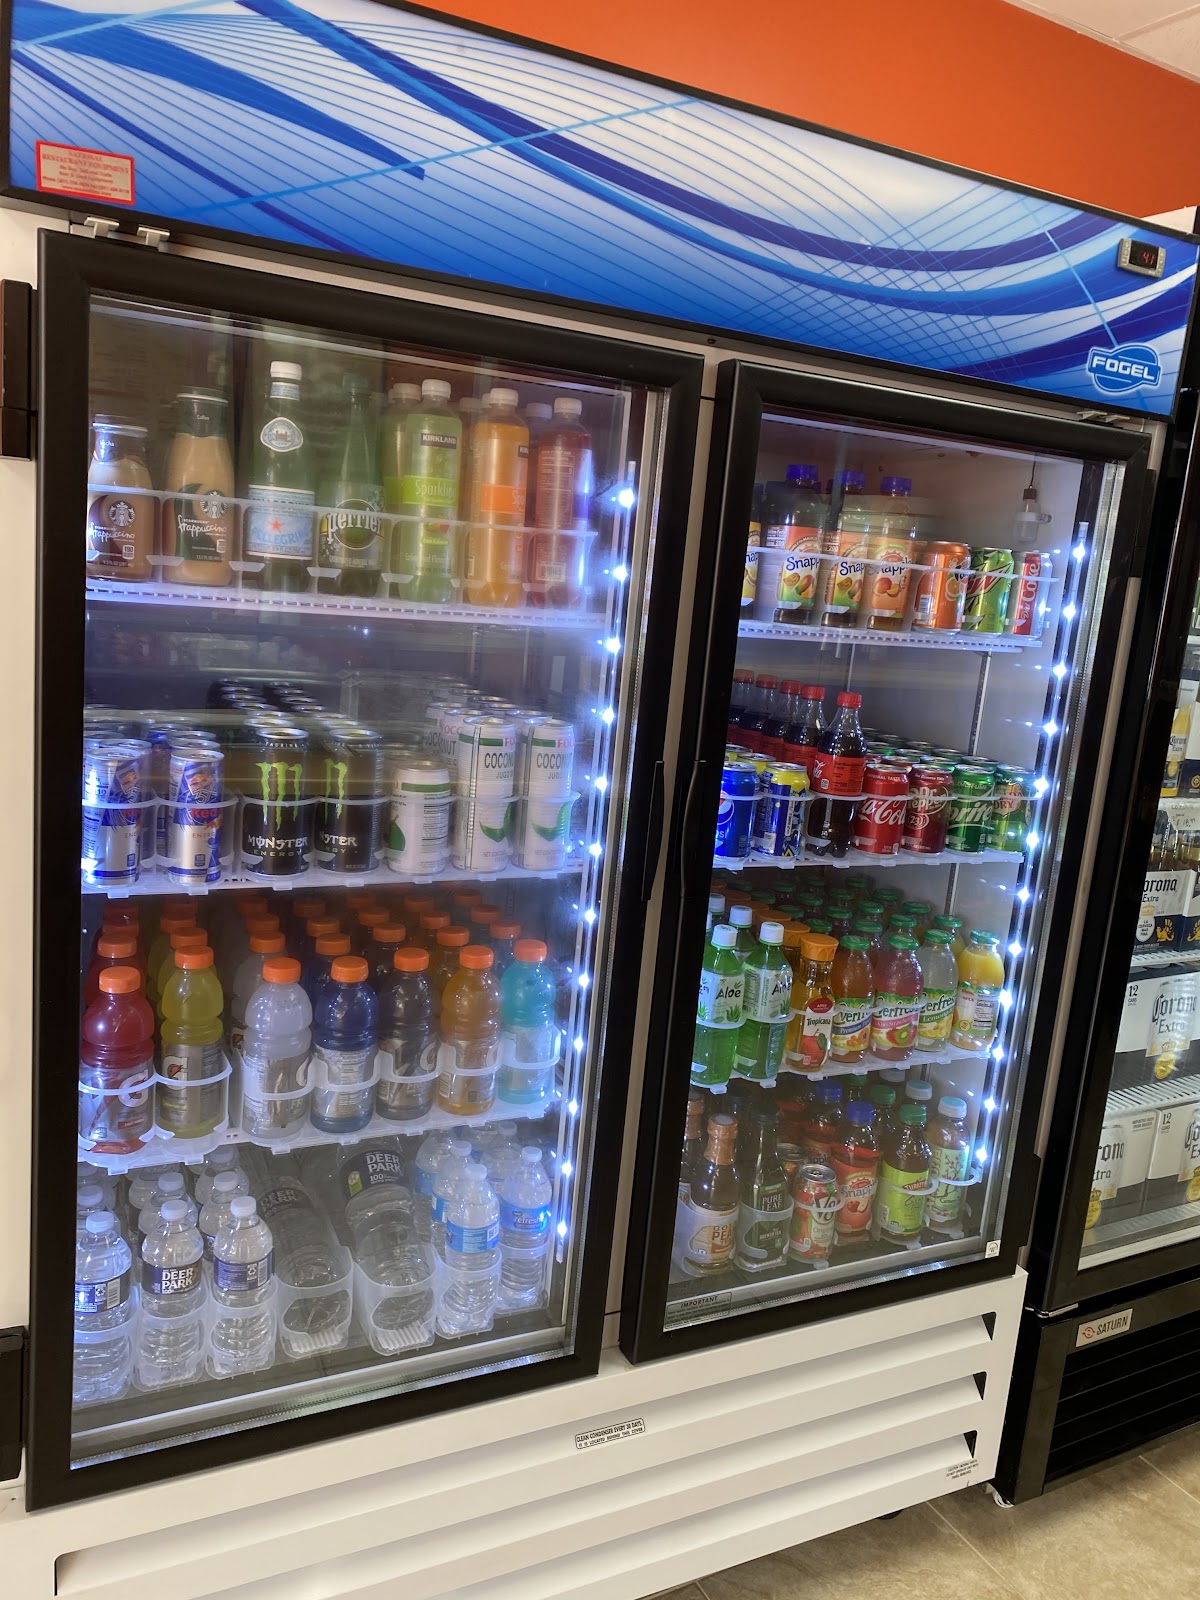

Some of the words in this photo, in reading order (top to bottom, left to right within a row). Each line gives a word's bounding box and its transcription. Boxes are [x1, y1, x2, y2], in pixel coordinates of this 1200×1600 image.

[1092, 355, 1155, 381] FOGEL
[422, 434, 457, 445] KIRKLAND
[1022, 563, 1041, 602] Coke
[484, 752, 514, 769] COCON
[993, 800, 1014, 810] DRY
[248, 834, 308, 850] MONSTER
[253, 848, 302, 857] ENERGY
[1143, 878, 1178, 893] orona
[1142, 893, 1160, 902] Extra
[715, 986, 742, 1000] Aloe
[1129, 985, 1139, 997] 12
[807, 1017, 831, 1027] Tropicana
[1158, 1018, 1185, 1034] Extra
[1162, 1112, 1172, 1125] 12
[366, 1153, 400, 1165] DEER
[367, 1162, 402, 1174] PARK
[762, 1193, 783, 1205] PURE
[762, 1202, 782, 1212] LEAF
[712, 1229, 732, 1241] PEA
[162, 1267, 194, 1281] DEER
[161, 1275, 193, 1291] PARK
[681, 1295, 718, 1308] IMPORTANT
[1097, 1316, 1128, 1336] SATURN
[576, 1434, 590, 1443] CLEAN
[589, 1428, 614, 1439] CONDENSER
[614, 1424, 626, 1433] EVERY
[631, 1420, 643, 1428] DAYS
[589, 1437, 606, 1445] LOCATED
